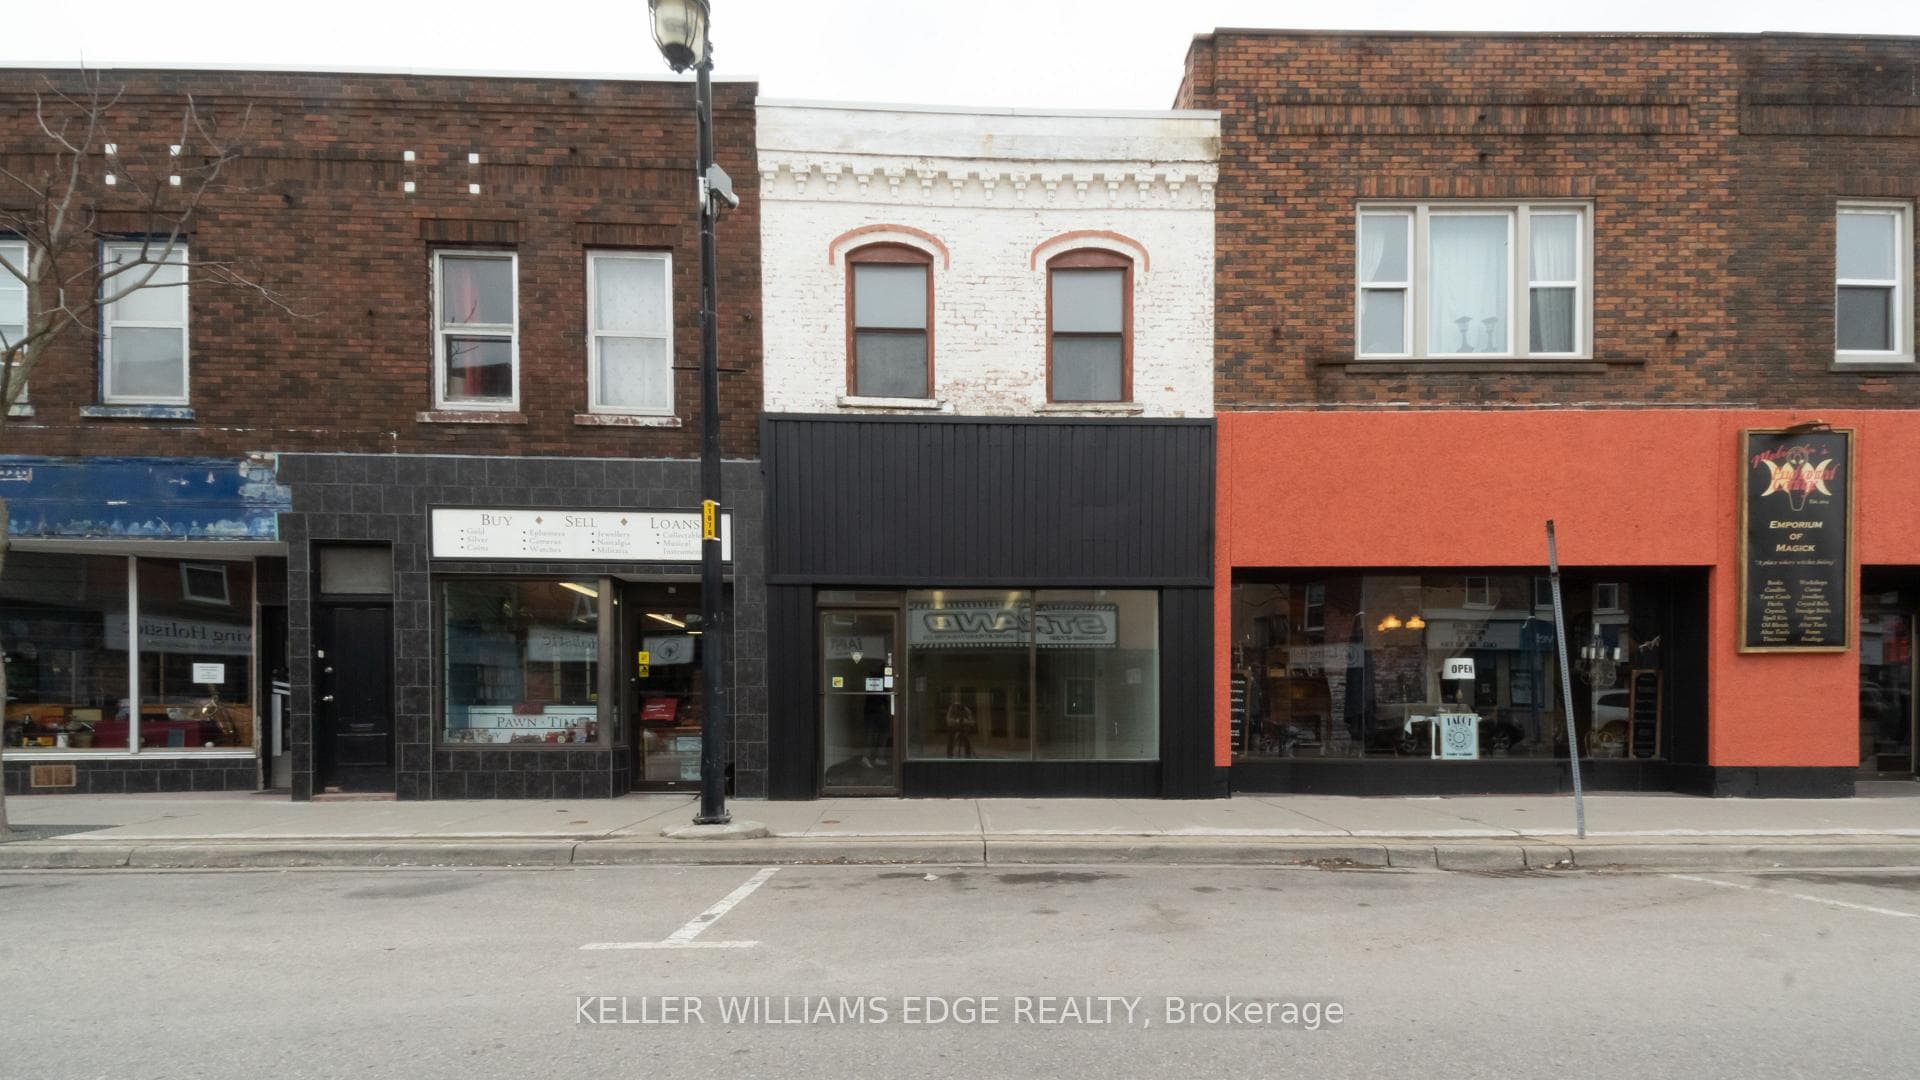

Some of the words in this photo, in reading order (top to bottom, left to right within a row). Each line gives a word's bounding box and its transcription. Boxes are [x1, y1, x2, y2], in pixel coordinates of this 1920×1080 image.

[481, 513, 512, 526] BUY
[565, 515, 598, 528] SELL
[650, 517, 700, 530] LOANS
[1769, 520, 1823, 529] EMPORIUM
[1775, 544, 1816, 552] MAGICK
[1451, 664, 1472, 673] OPEN
[497, 716, 536, 728] PAWN
